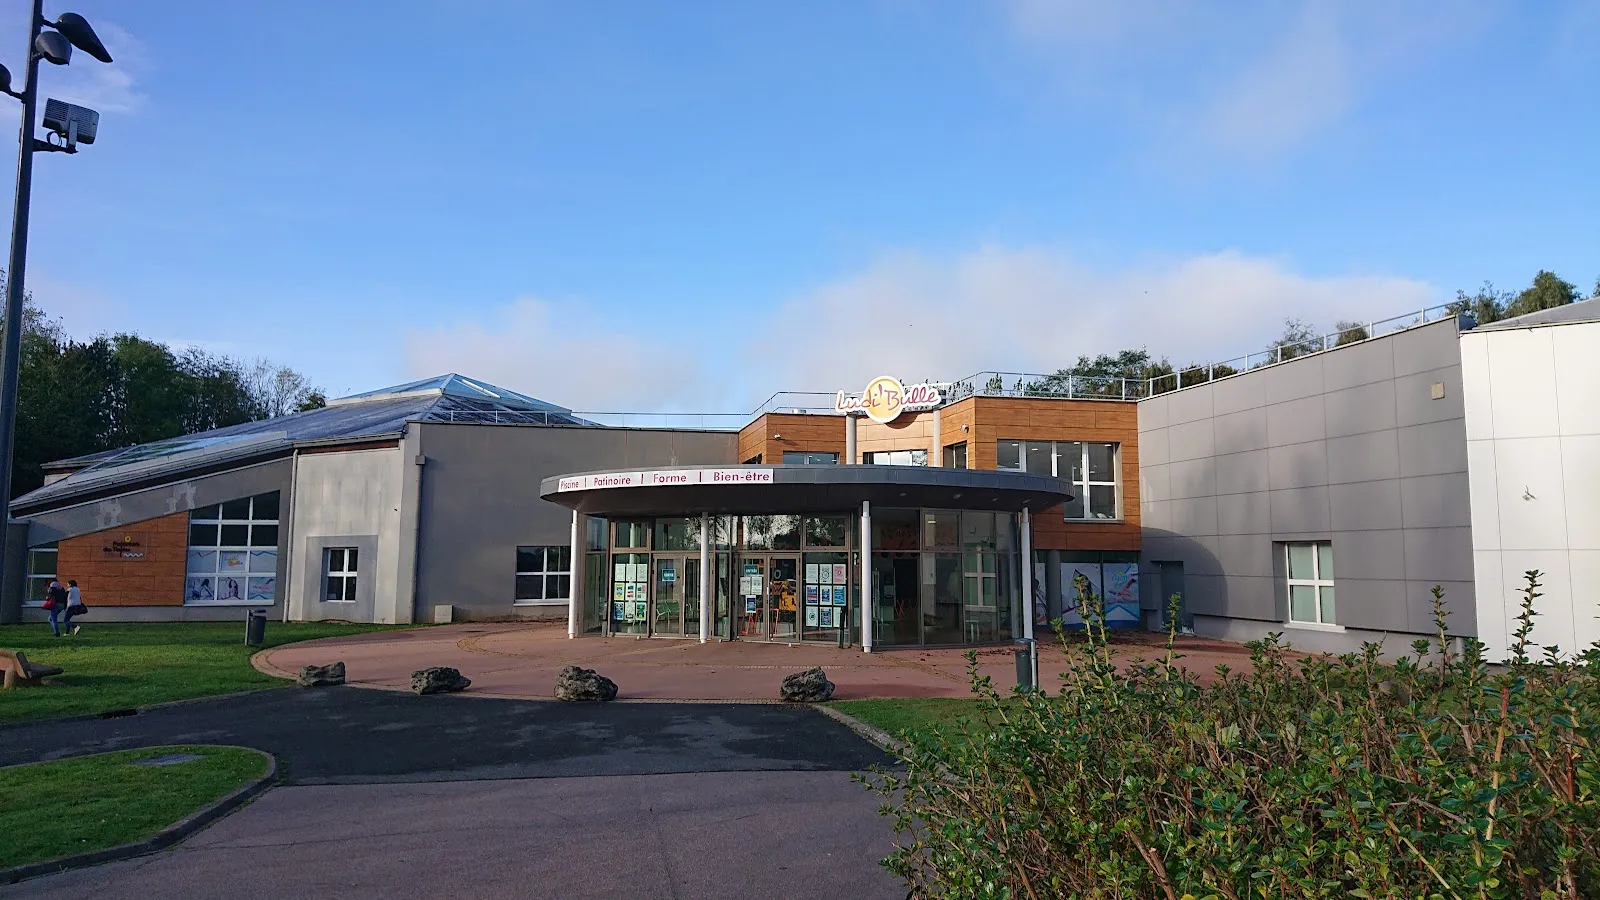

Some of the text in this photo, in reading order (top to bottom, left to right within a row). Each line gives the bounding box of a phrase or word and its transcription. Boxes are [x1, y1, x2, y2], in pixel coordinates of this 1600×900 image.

[560, 471, 770, 490] Piscine Patinoire Forme Bien-être
